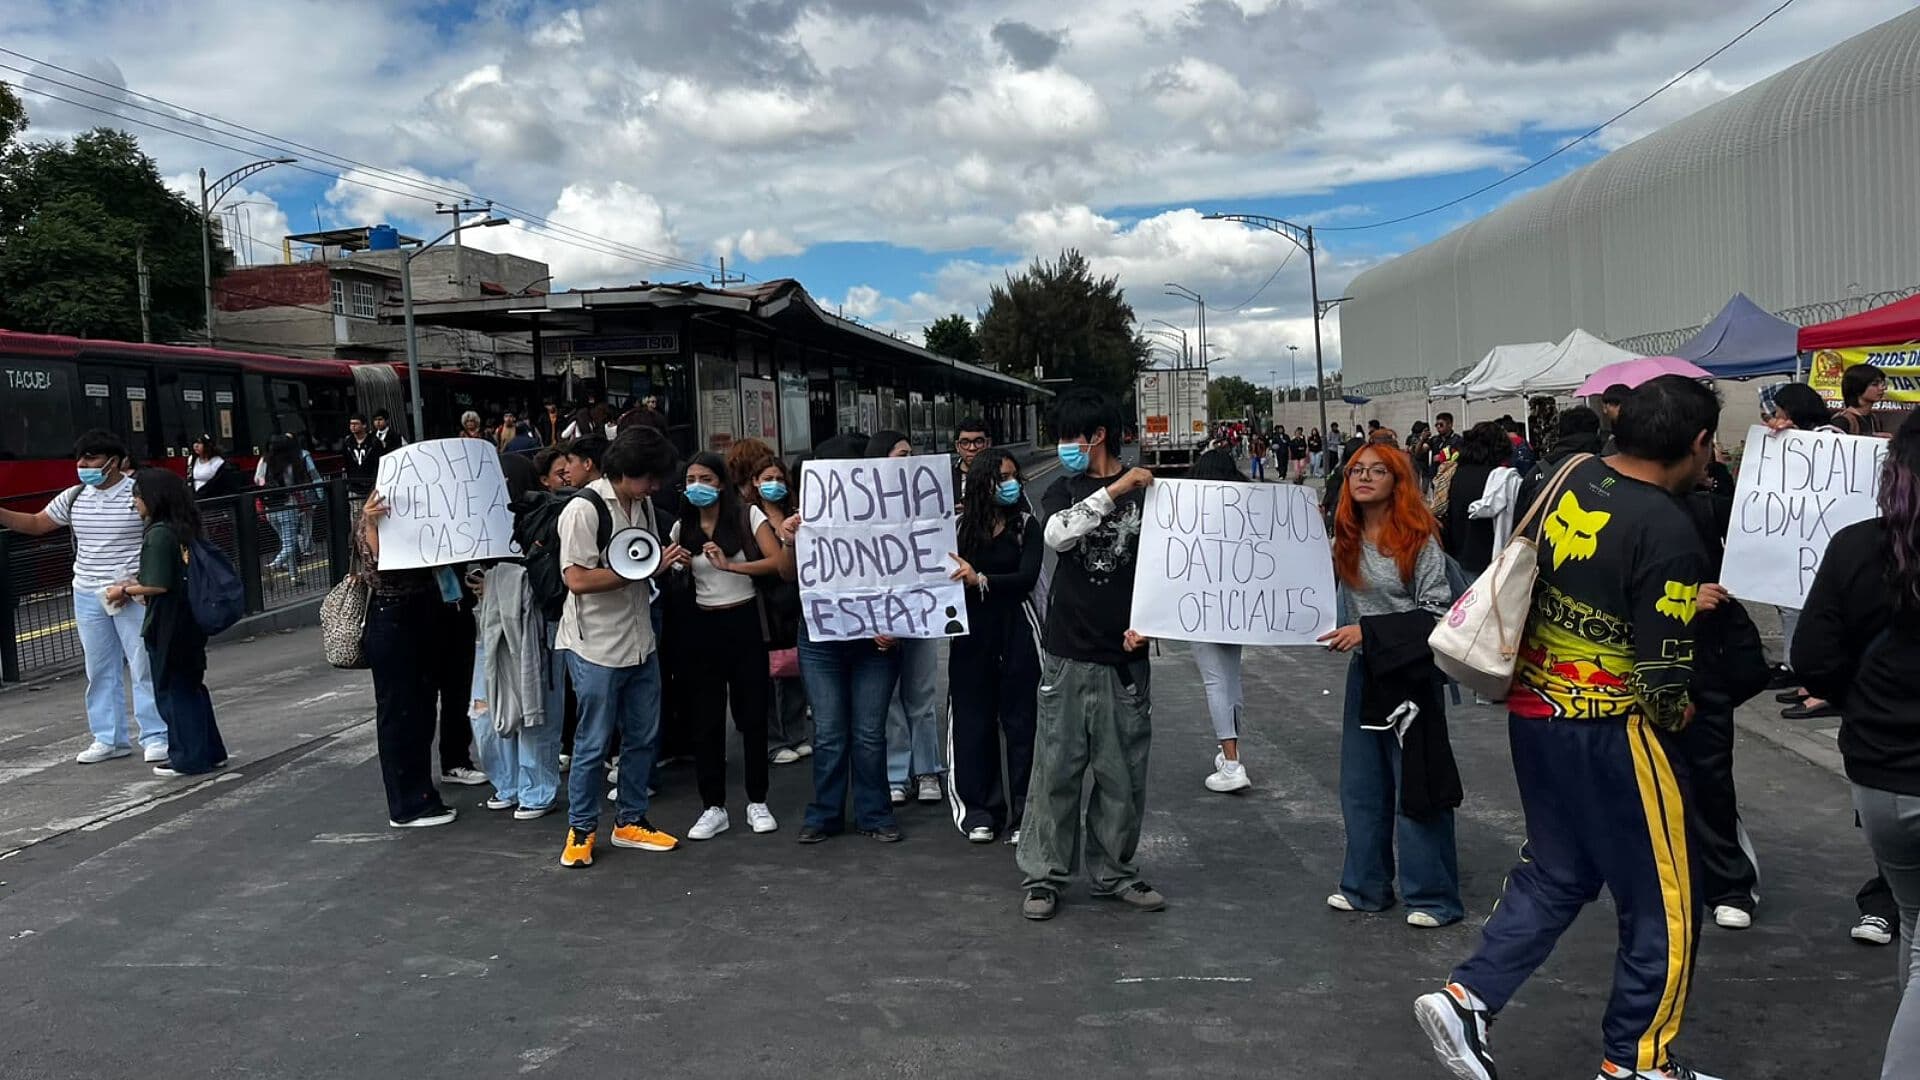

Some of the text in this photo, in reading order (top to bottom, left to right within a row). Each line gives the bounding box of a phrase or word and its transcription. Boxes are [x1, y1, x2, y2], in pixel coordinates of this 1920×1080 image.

[380, 439, 499, 487] DASHA
[1757, 433, 1880, 499] FISCALI
[487, 485, 507, 519] A
[802, 465, 951, 523] DASHA,
[1155, 481, 1325, 543] QUEREMOS
[1741, 491, 1837, 541] CDMX
[419, 518, 494, 564] CASA
[800, 528, 946, 588] ¿DONDE
[1166, 536, 1275, 583] DATOS
[1178, 587, 1321, 635] OFICIALES
